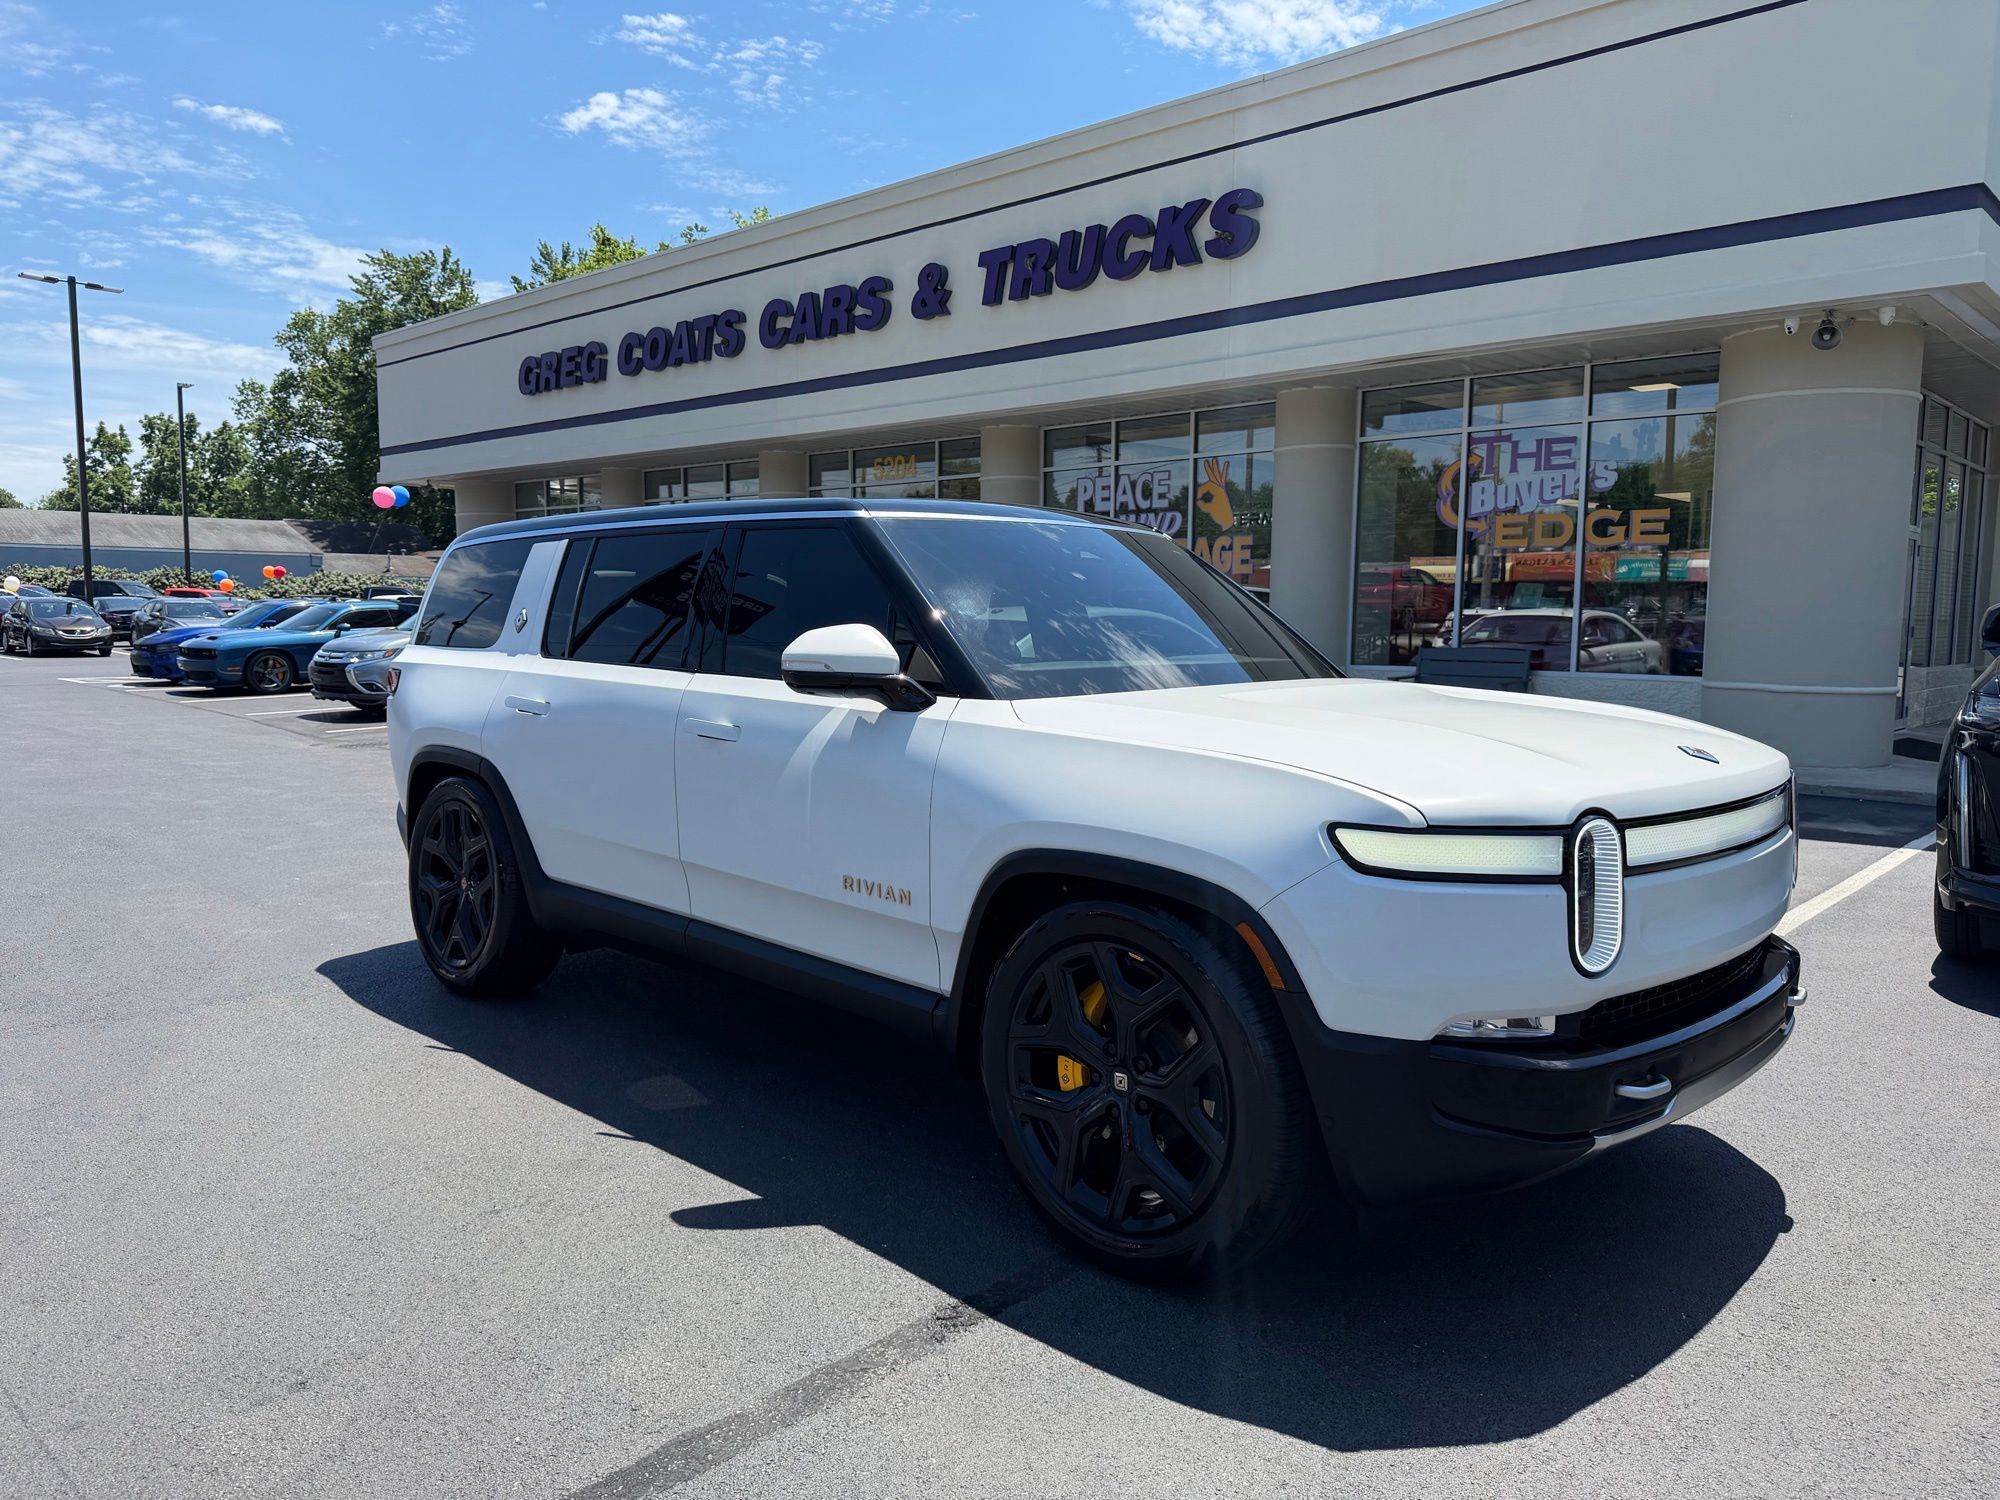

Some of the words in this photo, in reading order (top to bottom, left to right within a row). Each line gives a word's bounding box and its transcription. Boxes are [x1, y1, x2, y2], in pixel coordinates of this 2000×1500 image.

[518, 341, 608, 395] GREG
[617, 309, 747, 376] COATS
[758, 275, 893, 349] CARS
[911, 262, 952, 320] &
[978, 188, 1264, 306] TRUCKS
[1470, 433, 1577, 476] THE
[1076, 470, 1171, 513] PEACE
[1493, 507, 1670, 550] EDGE
[1175, 536, 1254, 575] AGE
[842, 874, 911, 906] RIVIAN
